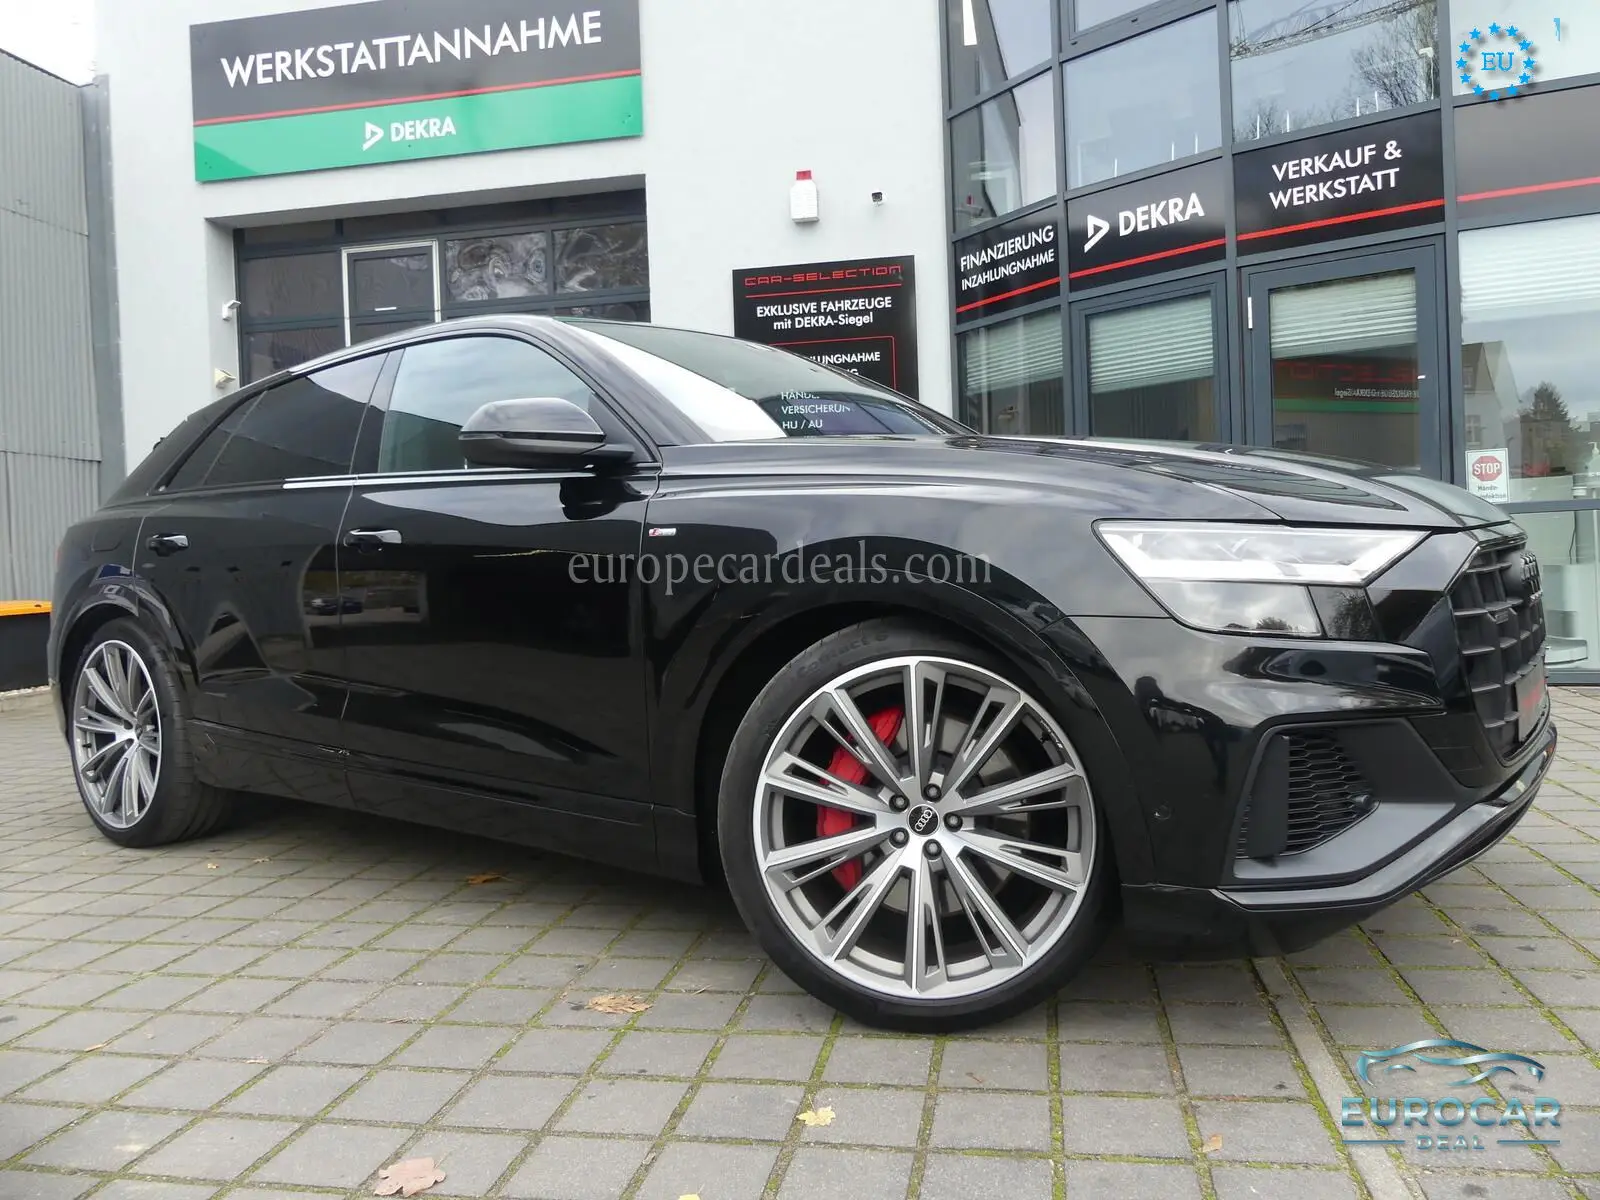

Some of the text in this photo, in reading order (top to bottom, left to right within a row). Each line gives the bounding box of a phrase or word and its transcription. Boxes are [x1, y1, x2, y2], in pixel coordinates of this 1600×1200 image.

[220, 11, 602, 88] WERKSTATTANNAHME
[390, 116, 457, 143] DEKRA
[1272, 140, 1402, 182] VERKAUF &
[1269, 167, 1401, 210] WERKSTATT
[1118, 192, 1205, 238] DEKRA
[960, 225, 1055, 272] FINANZIERUNG
[961, 249, 1055, 290] INZAHLUNGNAHME
[756, 296, 892, 318] EXKLUSIVE FAHRZEUGE
[773, 311, 874, 330] mit DEKRA-Siegel
[781, 403, 851, 415] VERSICHERUN
[782, 420, 798, 429] HU
[807, 419, 823, 429] AU
[1474, 462, 1500, 475] STOP
